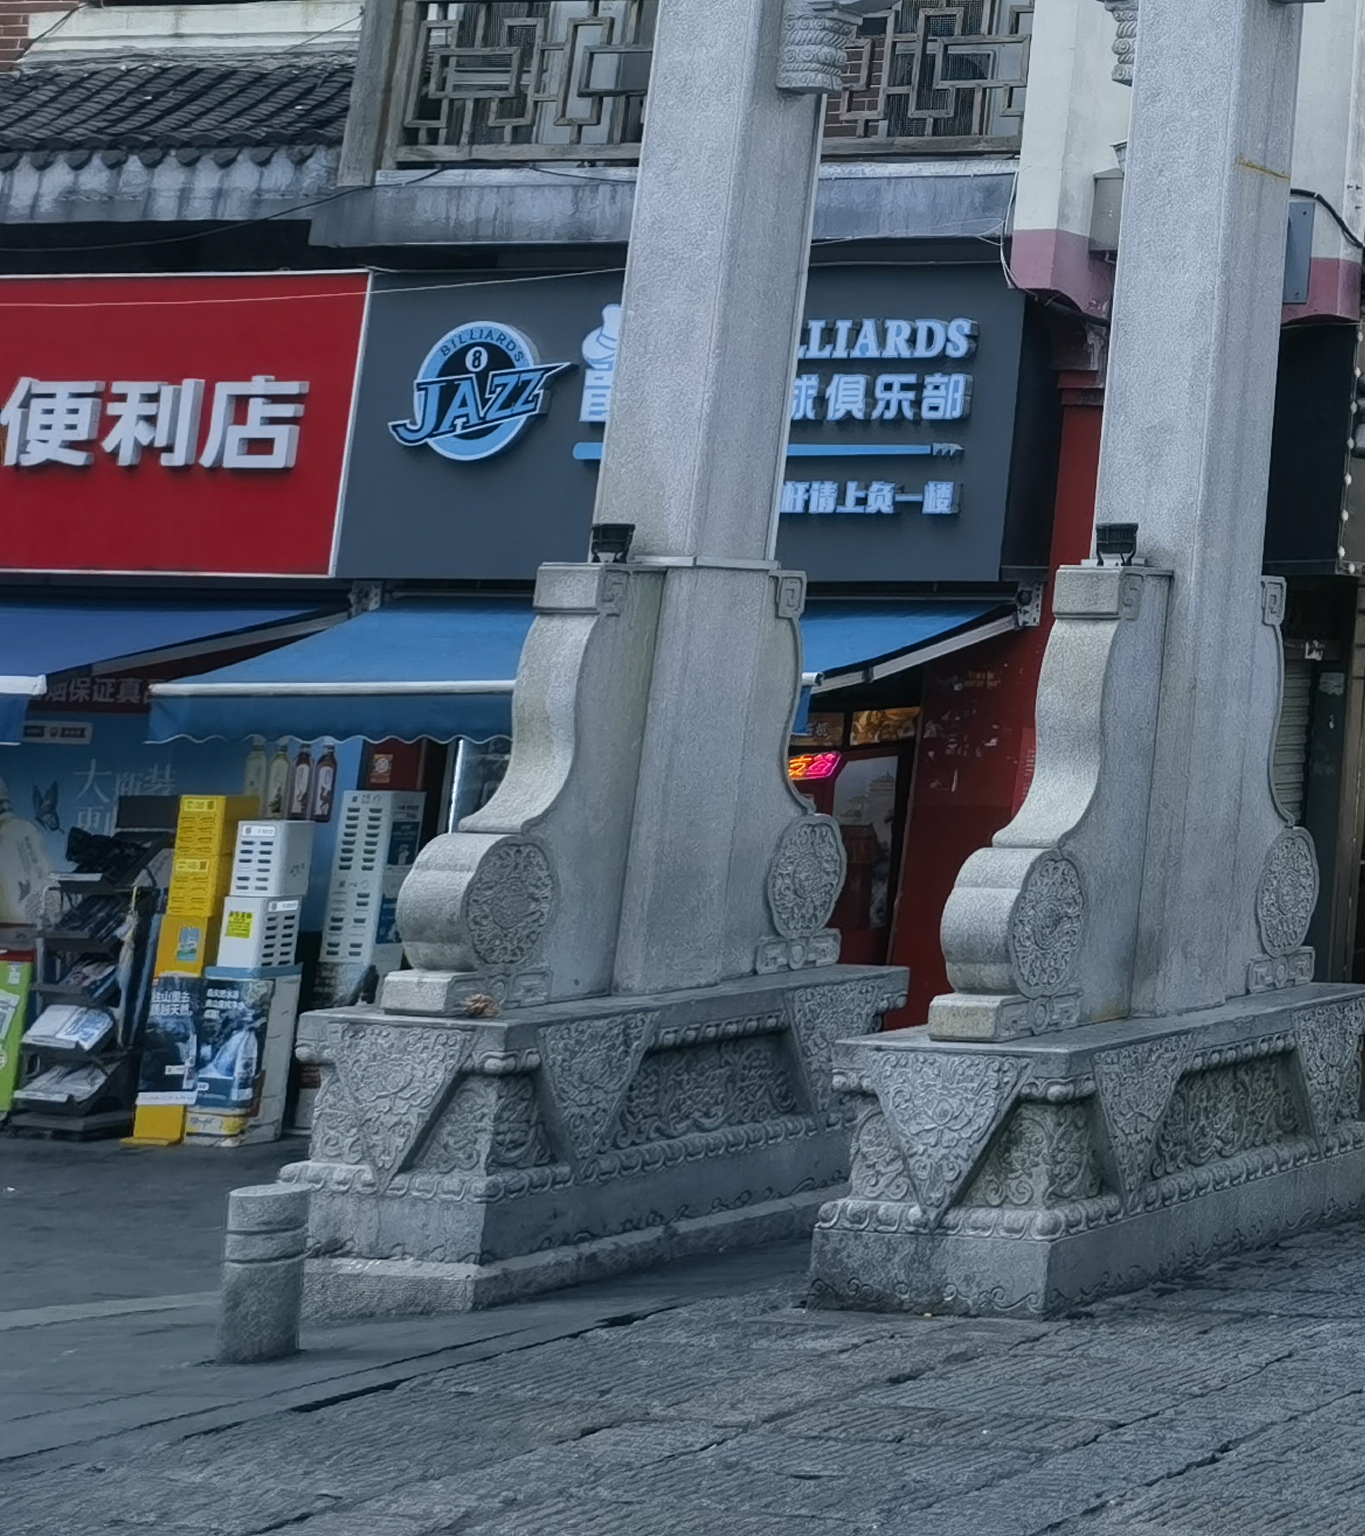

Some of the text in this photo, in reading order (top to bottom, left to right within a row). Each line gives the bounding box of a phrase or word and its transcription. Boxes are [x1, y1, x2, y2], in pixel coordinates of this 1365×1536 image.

[440, 328, 525, 363] BILLIARDS
[471, 349, 483, 369] 8
[798, 317, 971, 359] LIARDS
[0, 375, 309, 468] 便利店
[388, 366, 552, 446] JAZZ
